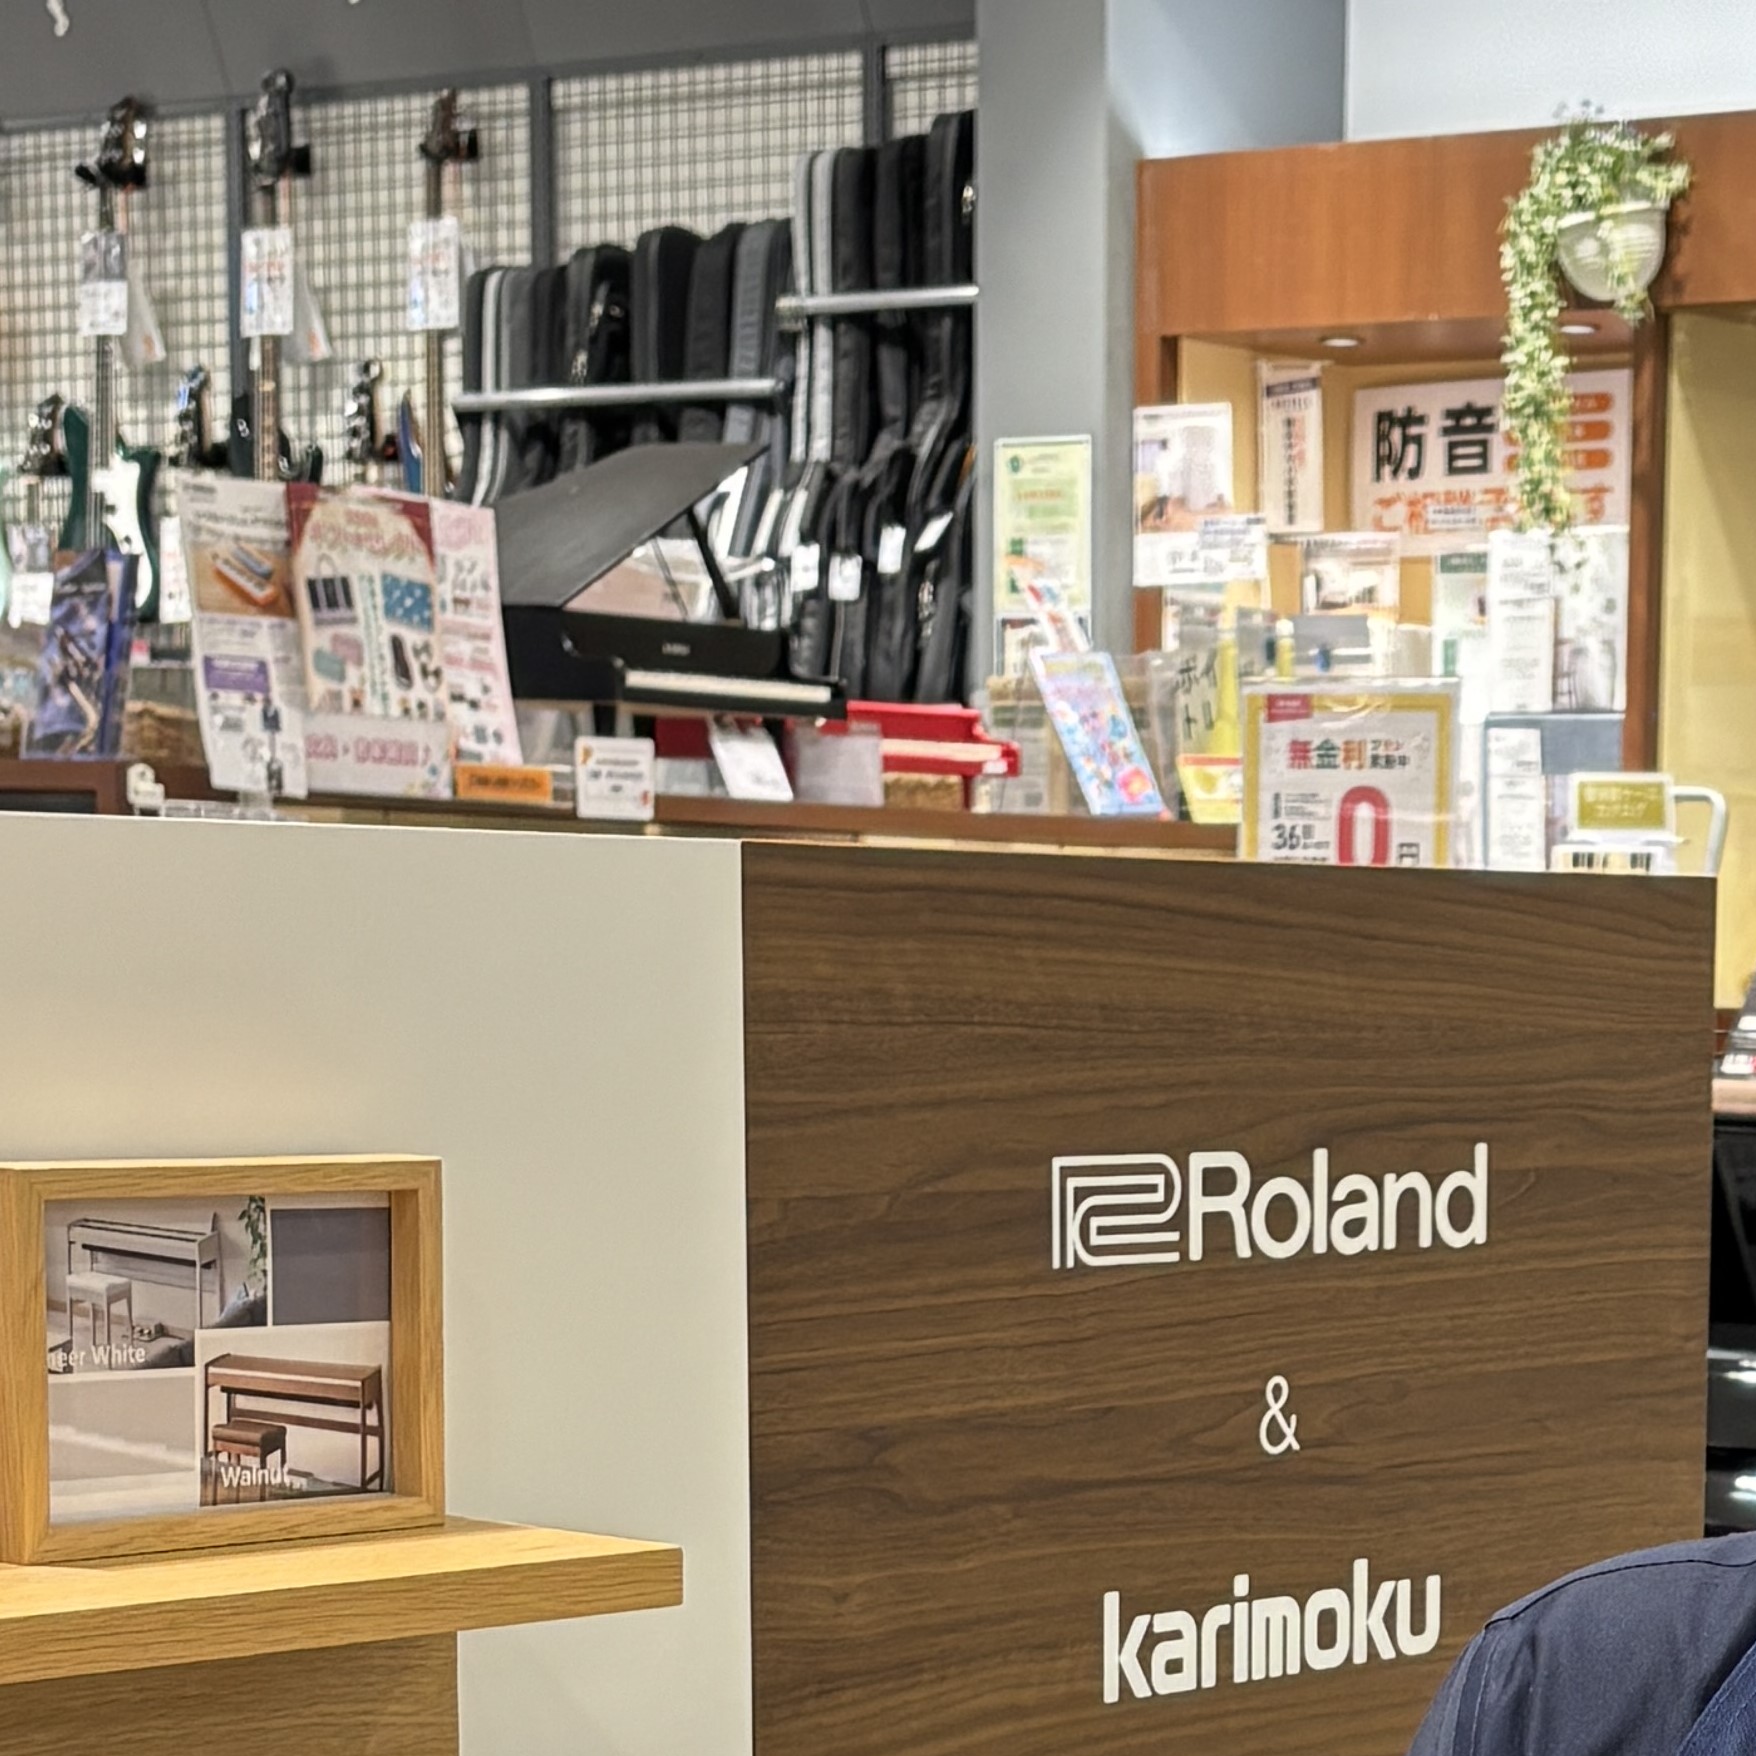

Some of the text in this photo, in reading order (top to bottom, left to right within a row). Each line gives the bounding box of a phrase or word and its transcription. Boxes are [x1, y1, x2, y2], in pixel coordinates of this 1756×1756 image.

[1372, 401, 1499, 484] 防音
[1188, 1142, 1489, 1261] Roland
[91, 1343, 146, 1367] White
[1259, 1375, 1300, 1455] &
[221, 1464, 290, 1489] Walnut
[1103, 1558, 1441, 1704] karimoku
